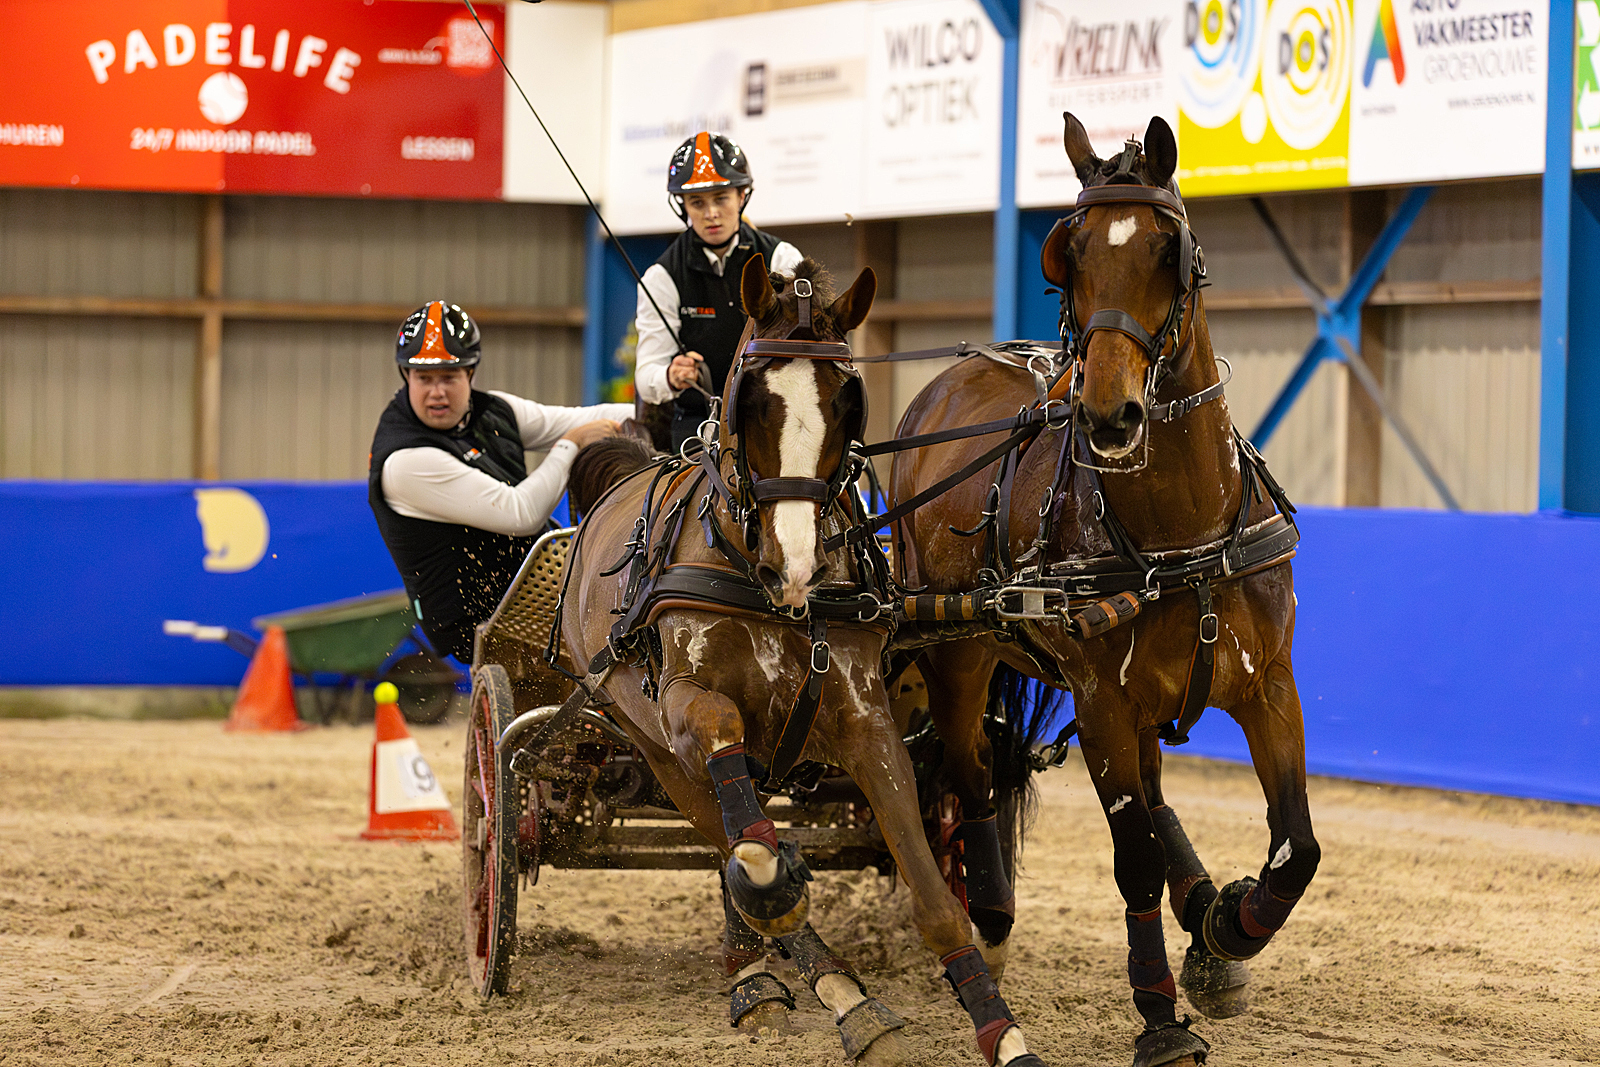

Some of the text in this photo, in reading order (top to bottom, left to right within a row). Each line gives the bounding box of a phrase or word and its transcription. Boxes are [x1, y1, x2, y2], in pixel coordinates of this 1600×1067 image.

[885, 18, 983, 69] WILCO
[1278, 27, 1331, 75] DOS
[1413, 11, 1533, 47] VAKMEESTER
[85, 22, 361, 94] PADELIFE
[883, 76, 981, 128] OPTIEK
[130, 127, 316, 156] 24/7 INDOOR PADEL
[411, 756, 435, 792] 9
